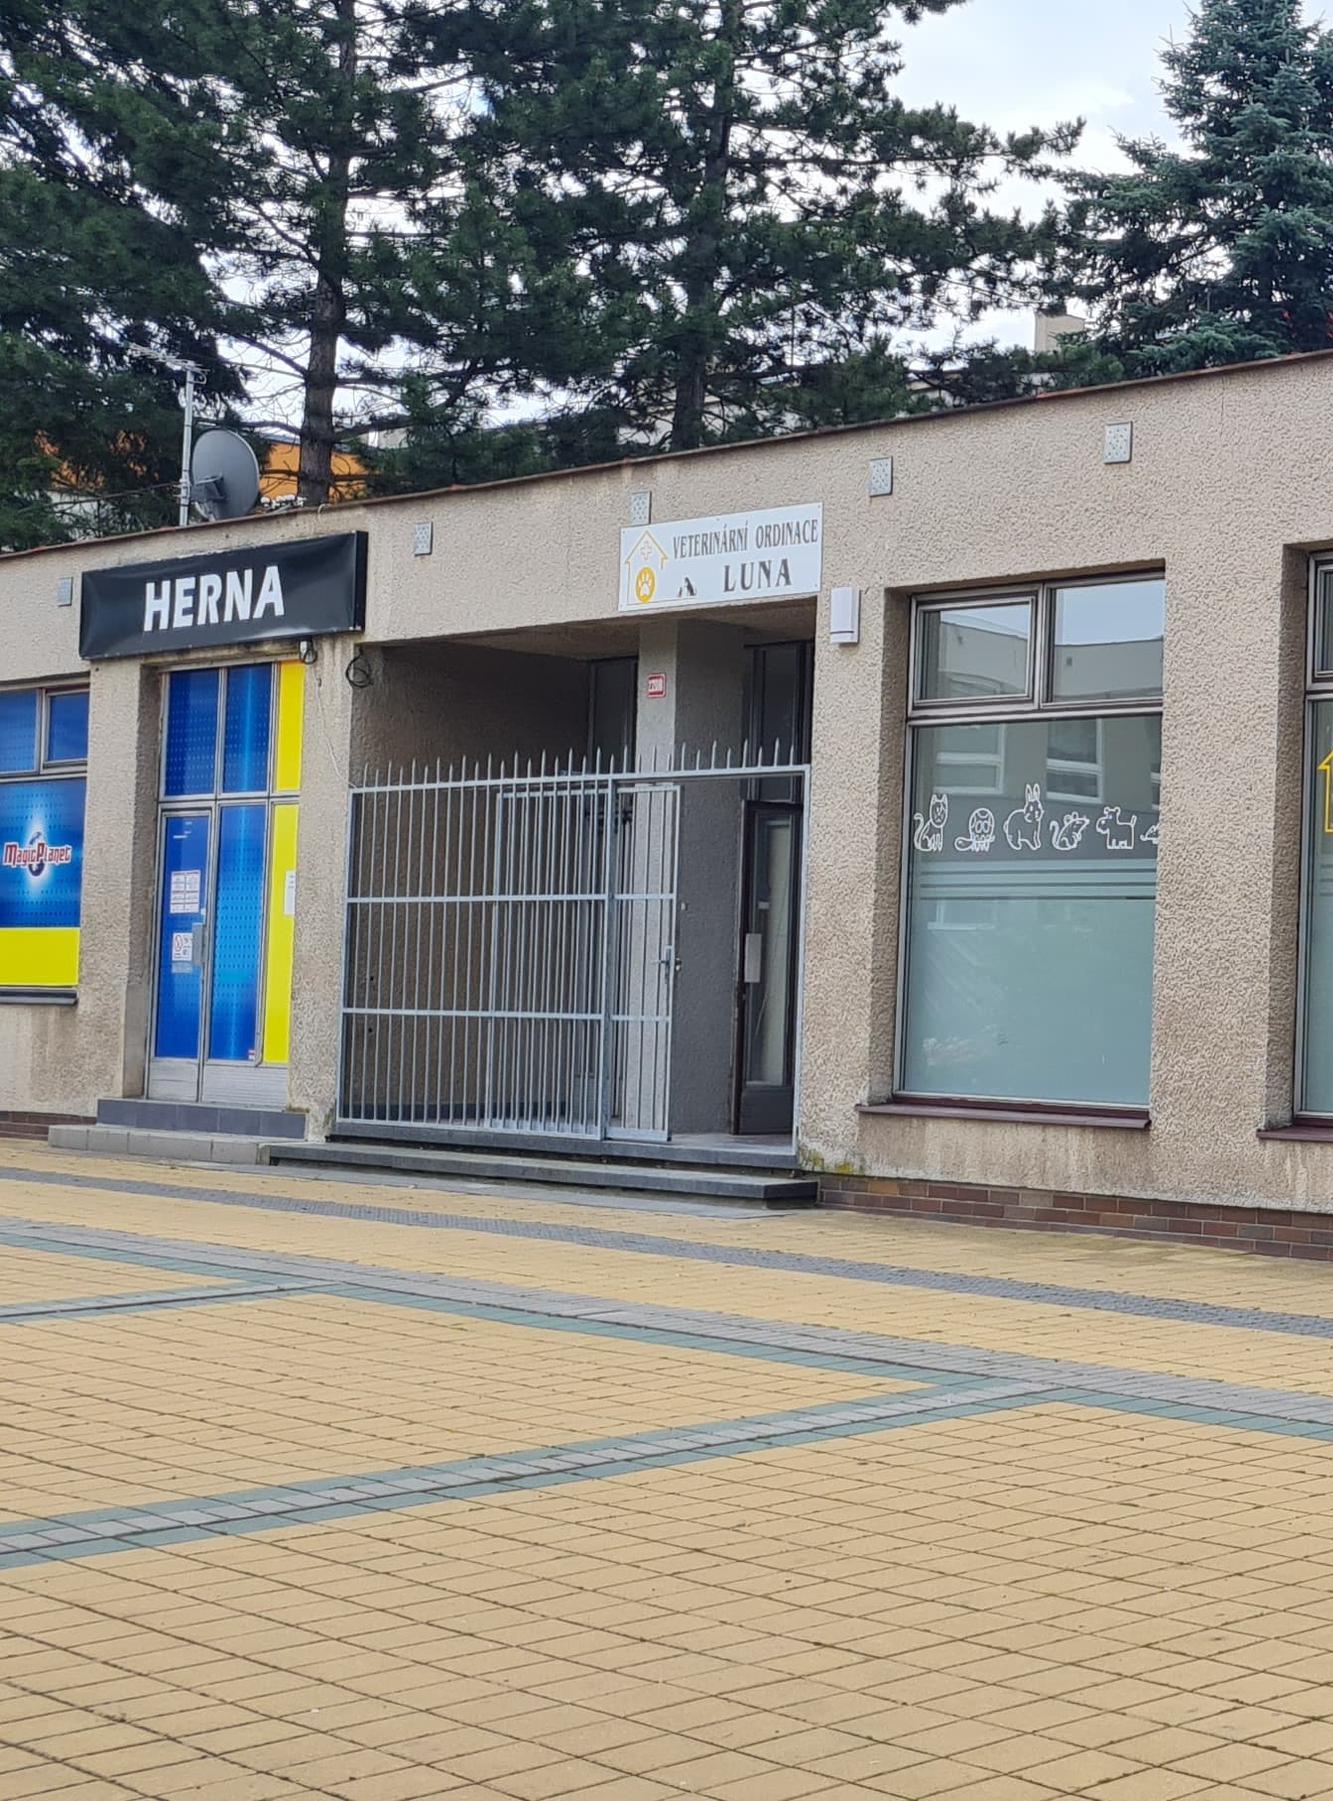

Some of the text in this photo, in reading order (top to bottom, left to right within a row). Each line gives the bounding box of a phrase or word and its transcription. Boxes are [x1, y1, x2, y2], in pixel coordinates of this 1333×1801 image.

[673, 519, 818, 559] VETERINÁRNÍ ORDINACE
[723, 558, 792, 593] LUNA
[143, 565, 285, 632] HERNA
